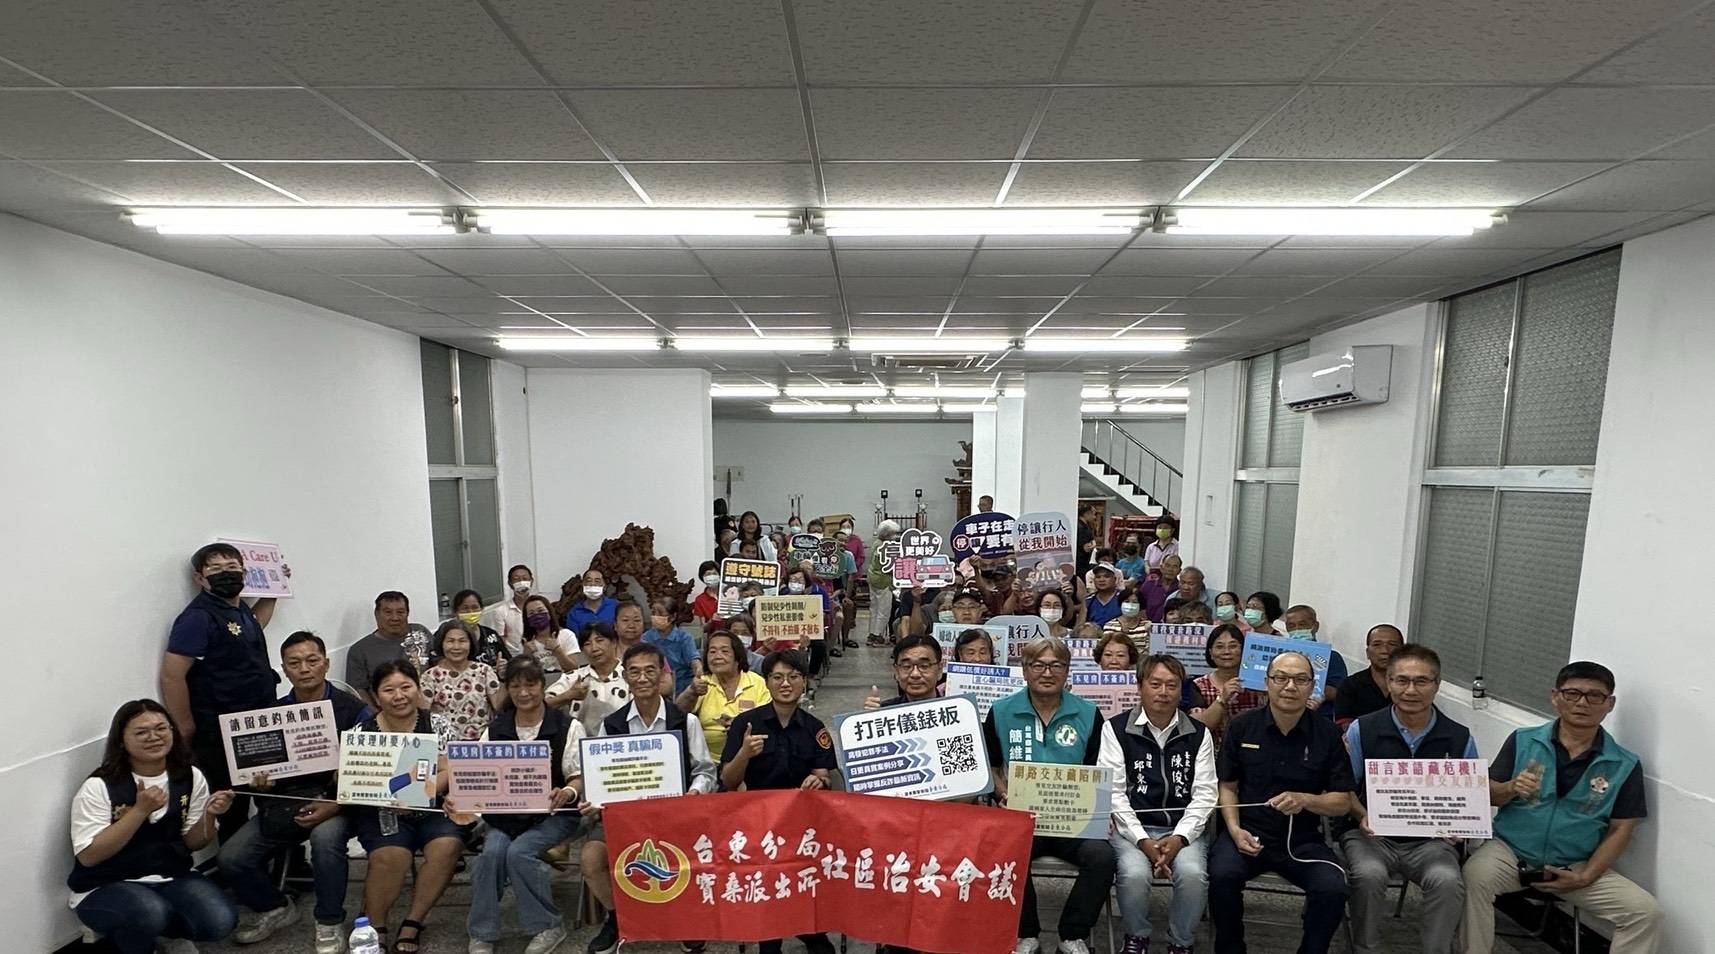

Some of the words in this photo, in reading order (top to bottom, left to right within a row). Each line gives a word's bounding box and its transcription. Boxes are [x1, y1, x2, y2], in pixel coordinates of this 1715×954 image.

[1017, 519, 1066, 536] 停讓行人
[910, 536, 930, 546] 世界
[1018, 534, 1068, 551] 從我開始
[906, 546, 934, 556] 更美好
[229, 706, 323, 731] 請留意釣魚簡訊
[854, 705, 960, 741] 打詐儀錶板
[346, 734, 421, 748] 投資理財要小心
[589, 742, 625, 755] 假中獎
[628, 739, 663, 752] 真騙局
[1009, 729, 1023, 760] 簡維
[1368, 761, 1477, 776] 甜言蜜語藏危機!
[693, 828, 821, 863] 台東分局
[820, 843, 1017, 906] 社區治安會議
[696, 866, 821, 905] 寶桑派出所
